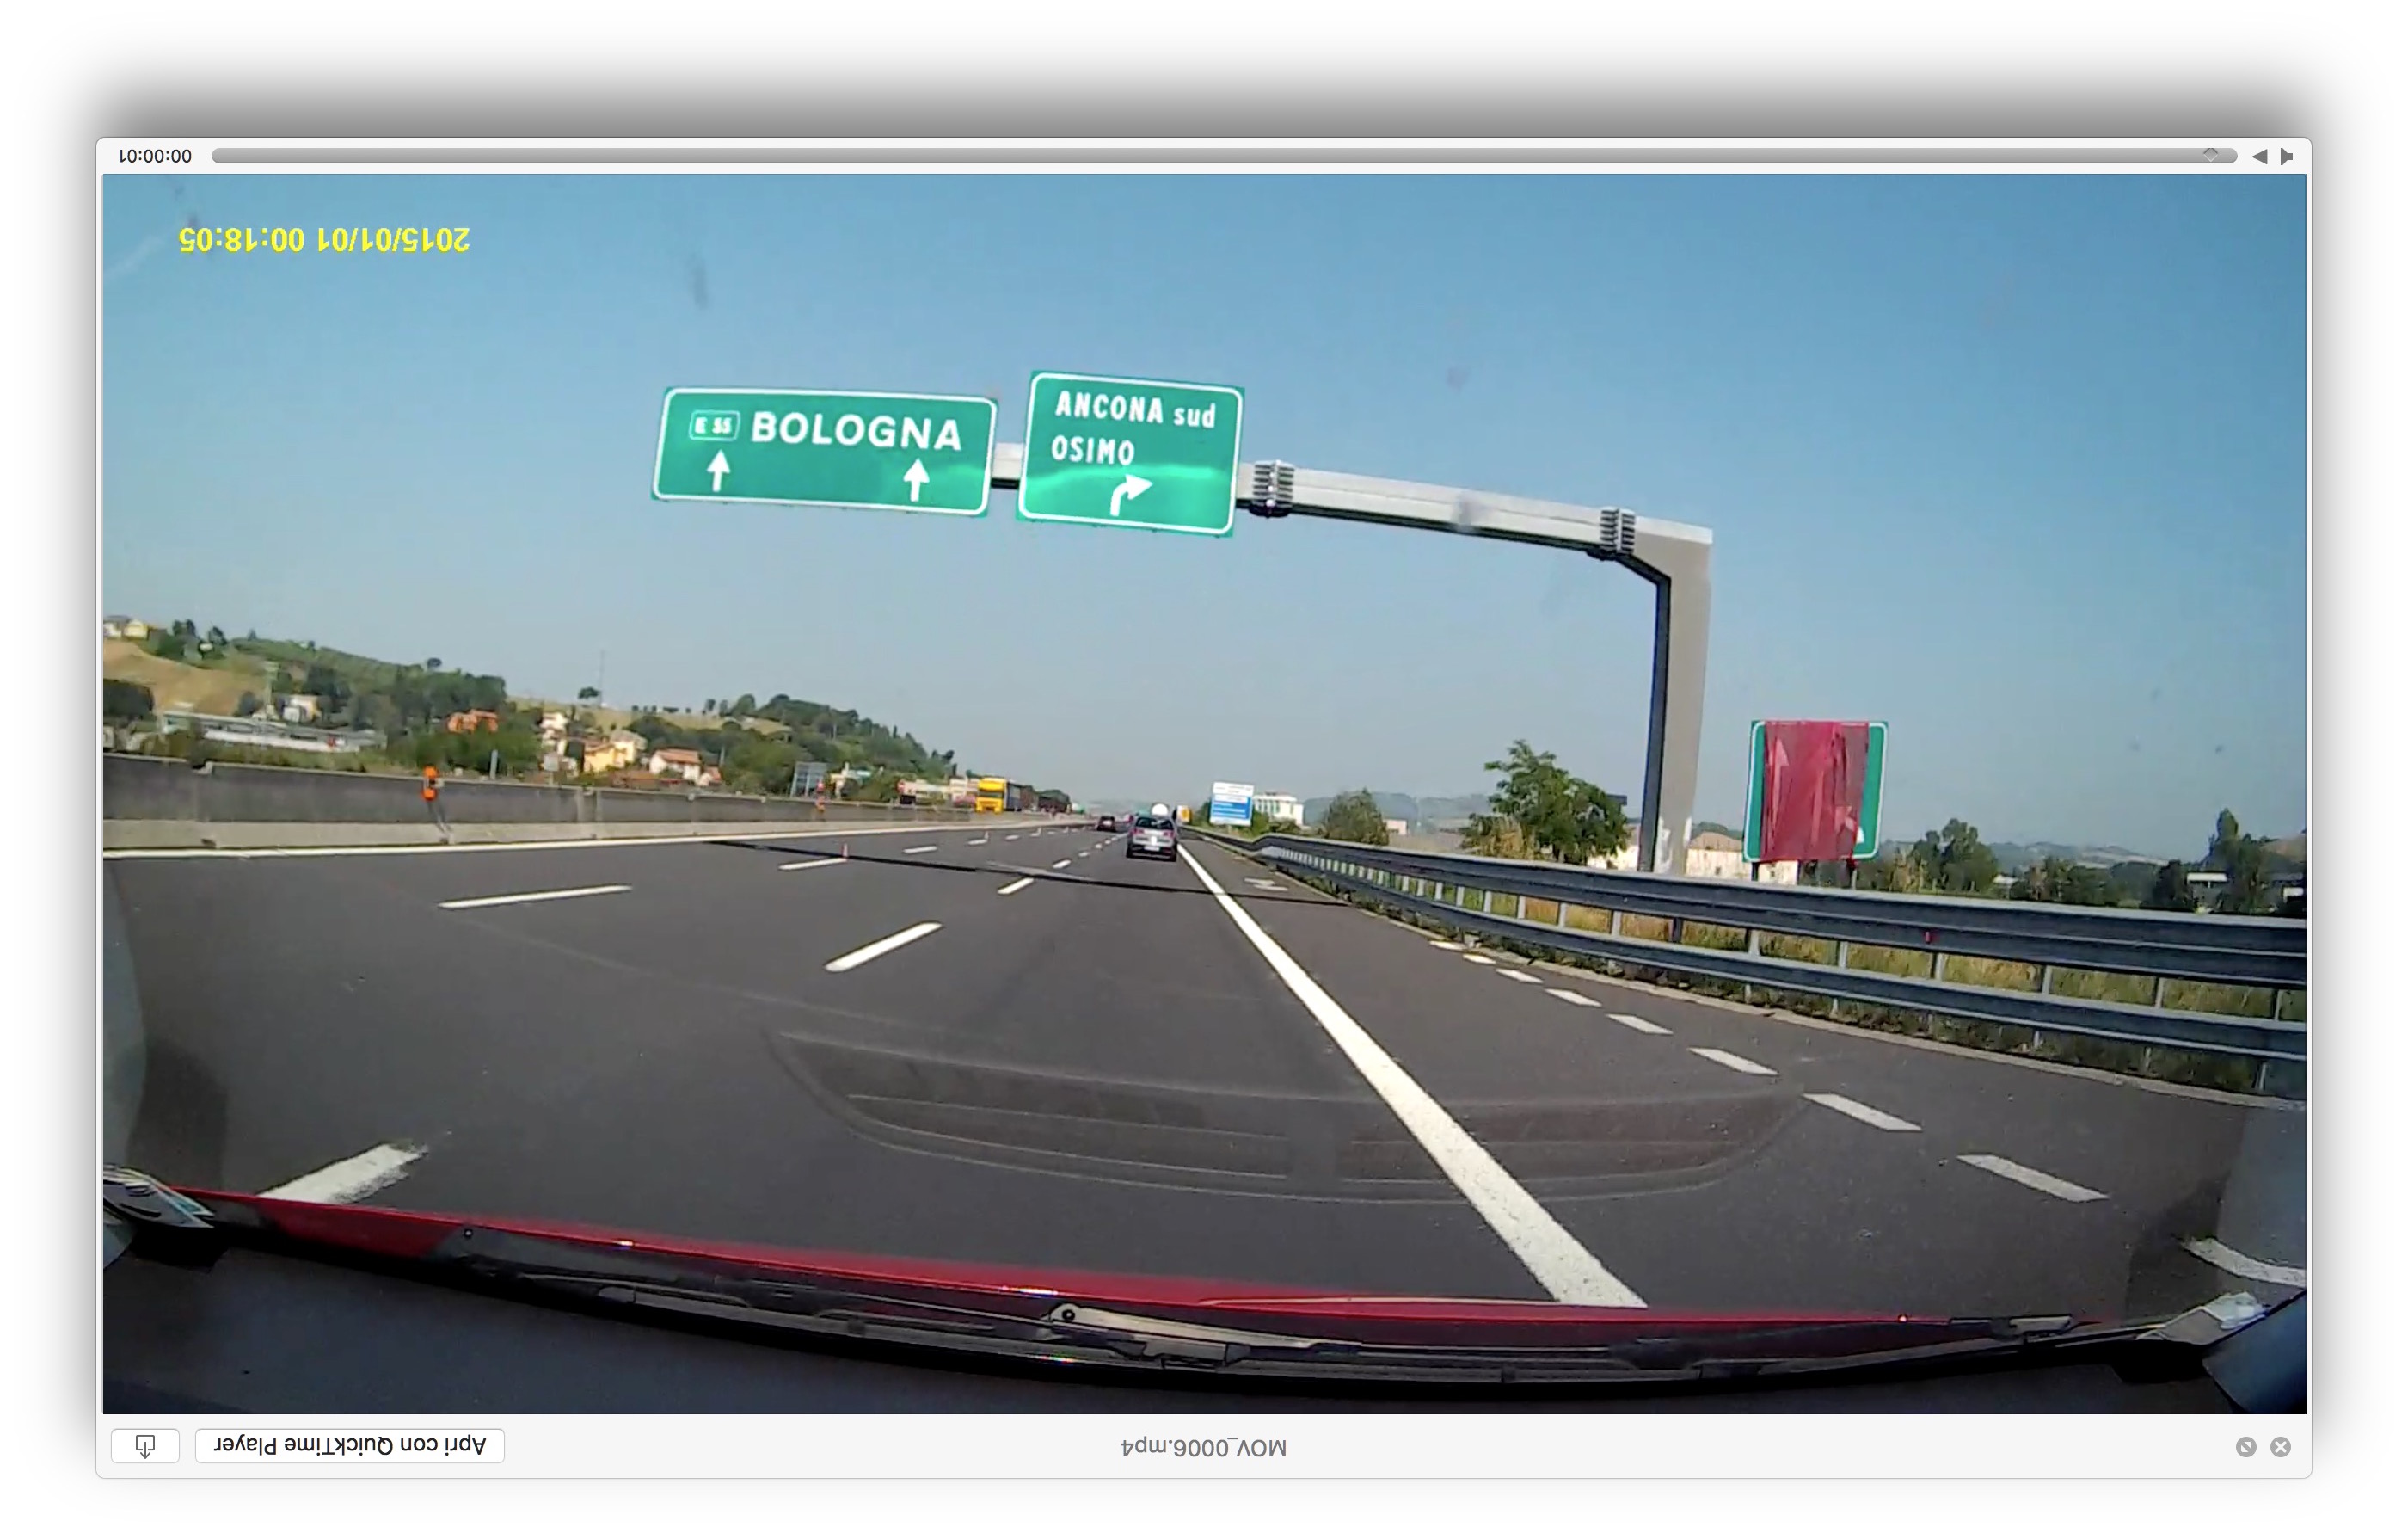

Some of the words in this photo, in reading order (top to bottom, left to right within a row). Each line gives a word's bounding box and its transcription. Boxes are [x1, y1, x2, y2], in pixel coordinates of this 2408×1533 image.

[119, 149, 192, 163] 00:00:01
[1054, 390, 1164, 424] ANCONA
[1172, 403, 1217, 429] sud
[695, 416, 707, 434] E
[752, 411, 962, 452] BOLOGNA
[1051, 434, 1135, 466] OSIMO
[213, 1434, 277, 1456] Player
[284, 1436, 394, 1456] QuickTime
[400, 1437, 439, 1452] con
[444, 1434, 487, 1456] Apri
[1121, 1435, 1287, 1457] MOV_0006.mp4
